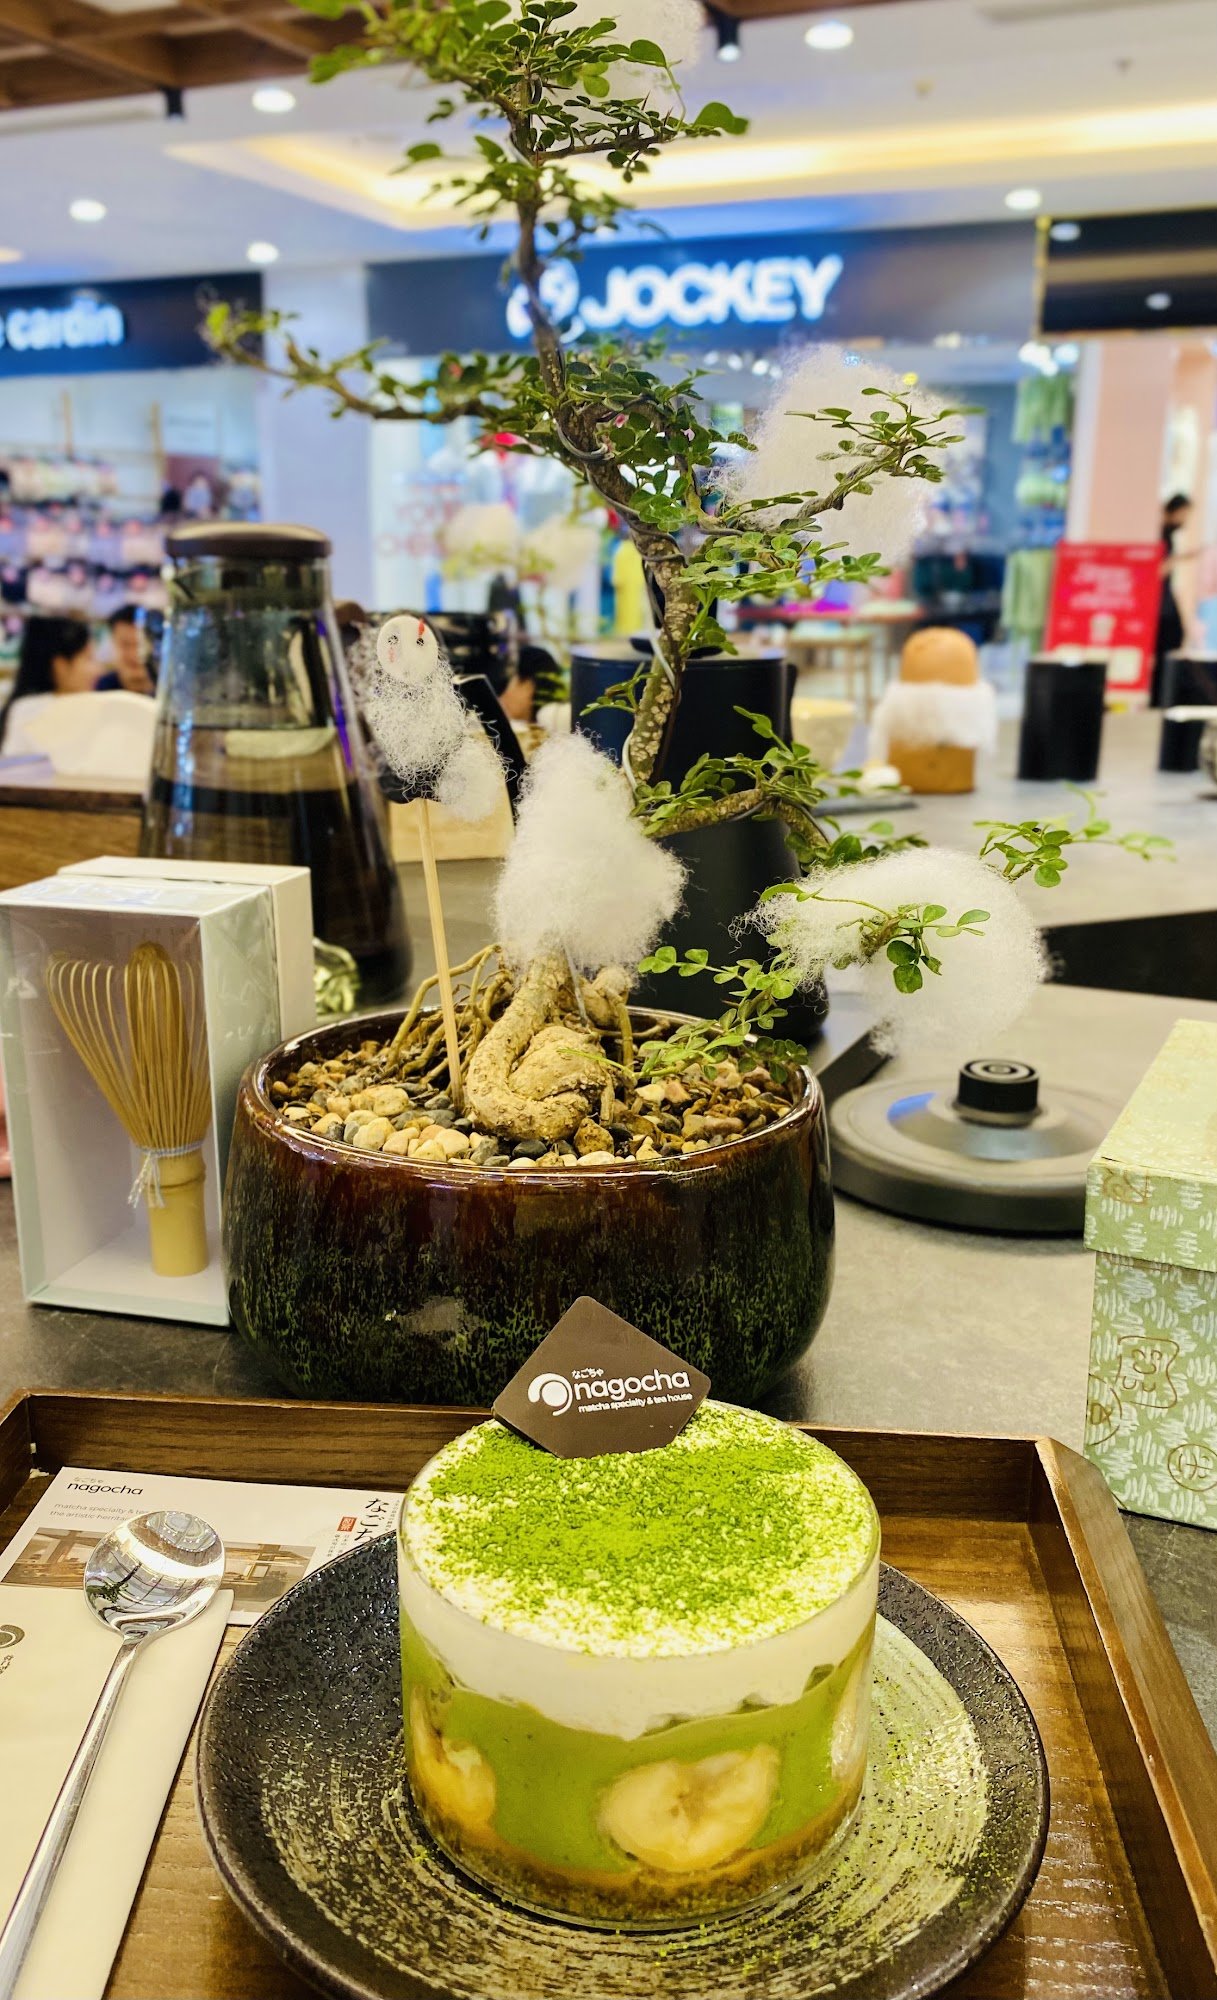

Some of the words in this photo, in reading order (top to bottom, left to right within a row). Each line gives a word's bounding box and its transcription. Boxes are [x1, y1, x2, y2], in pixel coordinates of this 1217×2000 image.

[579, 254, 843, 328] JOCKEY
[573, 1368, 690, 1401] nagocha
[578, 1401, 610, 1413] matcha
[611, 1398, 646, 1410] specialty
[646, 1396, 653, 1405] &
[653, 1396, 667, 1404] tea
[667, 1393, 693, 1403] house
[67, 1483, 143, 1495] nagocha
[54, 1503, 88, 1511] matcha
[89, 1504, 127, 1514] specialty
[66, 1511, 95, 1519] artistic
